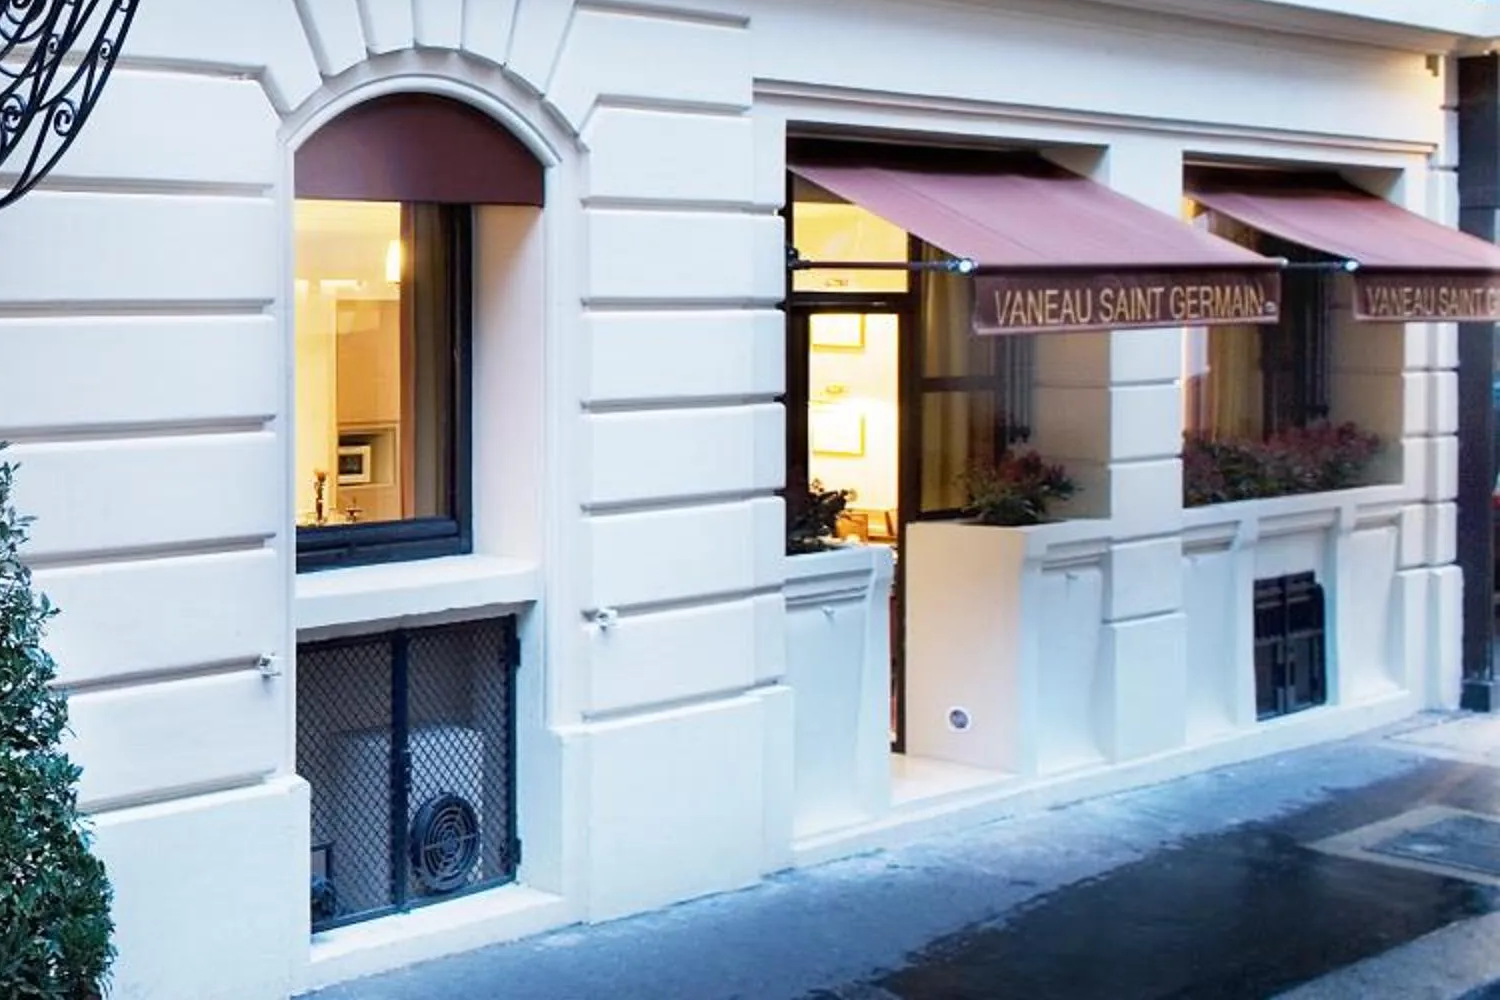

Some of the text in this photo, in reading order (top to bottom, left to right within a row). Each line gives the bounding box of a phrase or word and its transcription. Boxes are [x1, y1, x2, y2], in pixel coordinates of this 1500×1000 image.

[994, 284, 1264, 326] VANEAU SAINT GERMAIN
[1365, 286, 1436, 316] VANEAU
[1439, 286, 1484, 317] SAINT
